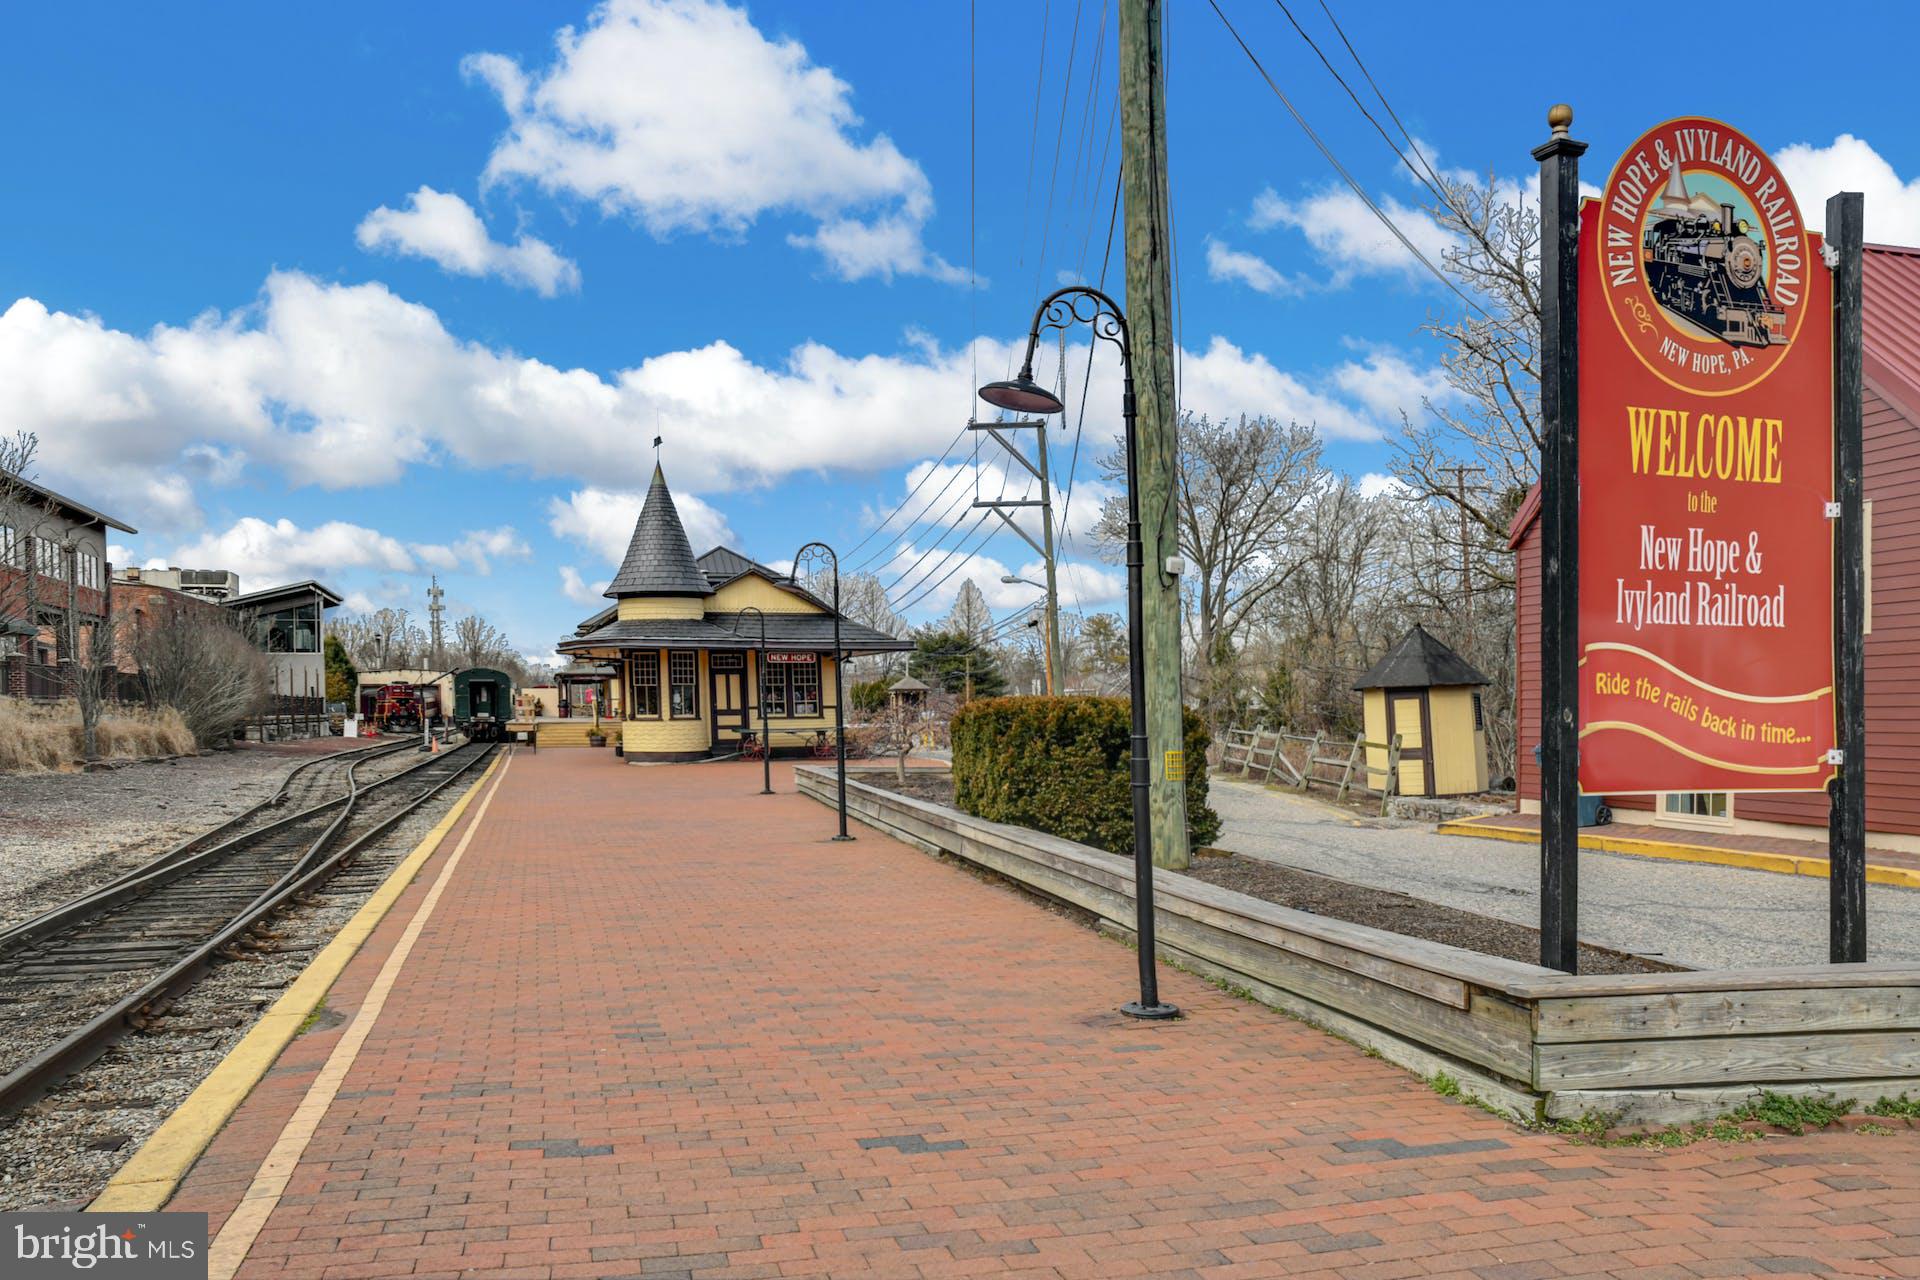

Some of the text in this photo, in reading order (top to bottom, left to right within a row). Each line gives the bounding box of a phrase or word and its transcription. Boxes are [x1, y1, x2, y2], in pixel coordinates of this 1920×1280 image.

[1608, 128, 1801, 306] NEW HOPE & IVYLAND RAILROAD
[1659, 336, 1754, 375] NEW HOPE, PA.
[1626, 405, 1783, 484] WELCOME
[1687, 490, 1718, 514] to the
[1639, 524, 1763, 580] New Hope &
[1616, 578, 1785, 632] Ivyland Railroad
[1595, 671, 1812, 744] Ride the rails back in time...
